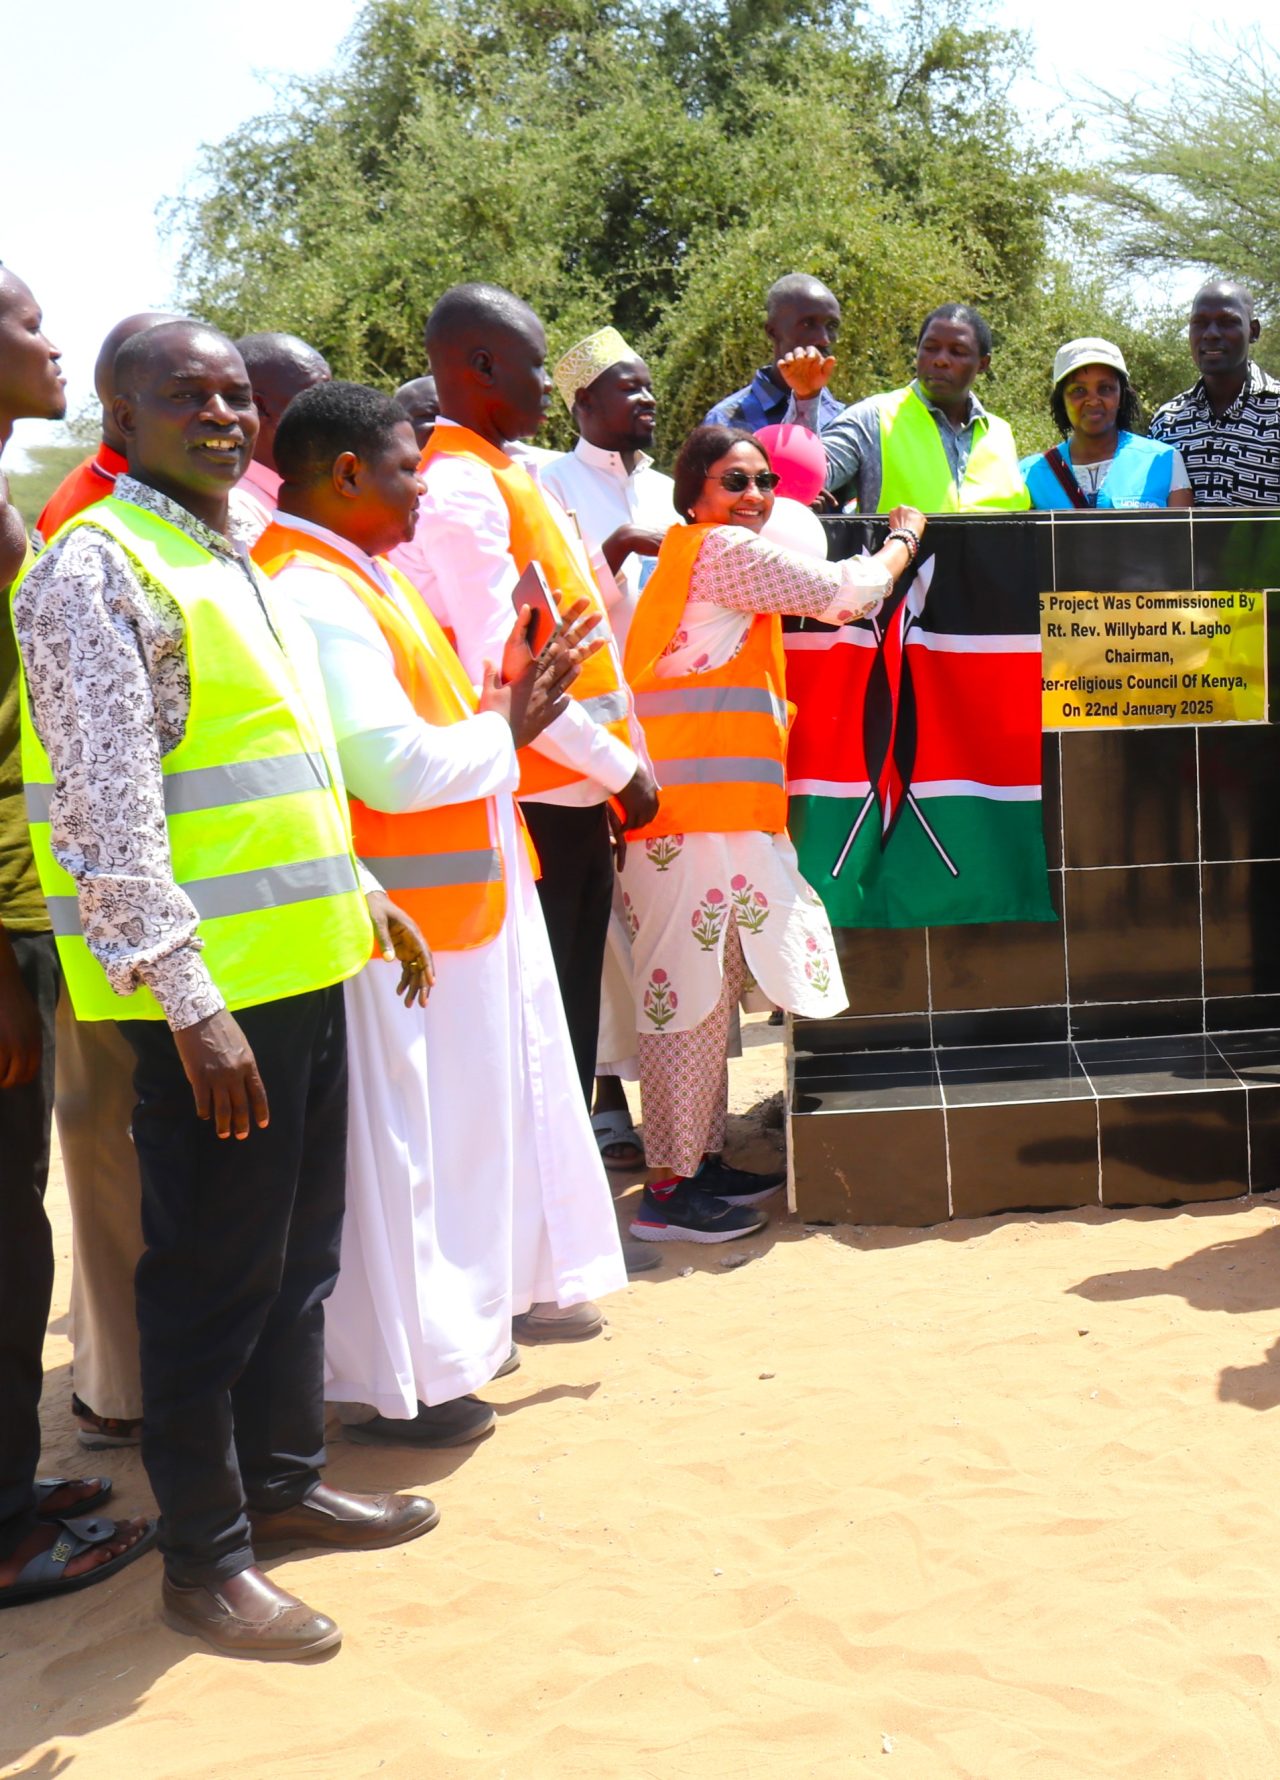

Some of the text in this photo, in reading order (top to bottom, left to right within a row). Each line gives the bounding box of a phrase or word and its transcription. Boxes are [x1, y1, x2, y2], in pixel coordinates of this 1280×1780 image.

[1040, 594, 1255, 614] s Project Was Commissioned By
[1047, 621, 1231, 640] Rt. Rev. Willybard K. Lagho
[1105, 649, 1174, 666] Chairman,
[1041, 673, 1248, 694] ter-religious Council Of Kenya,
[1062, 700, 1214, 719] On 22nd January 2025
